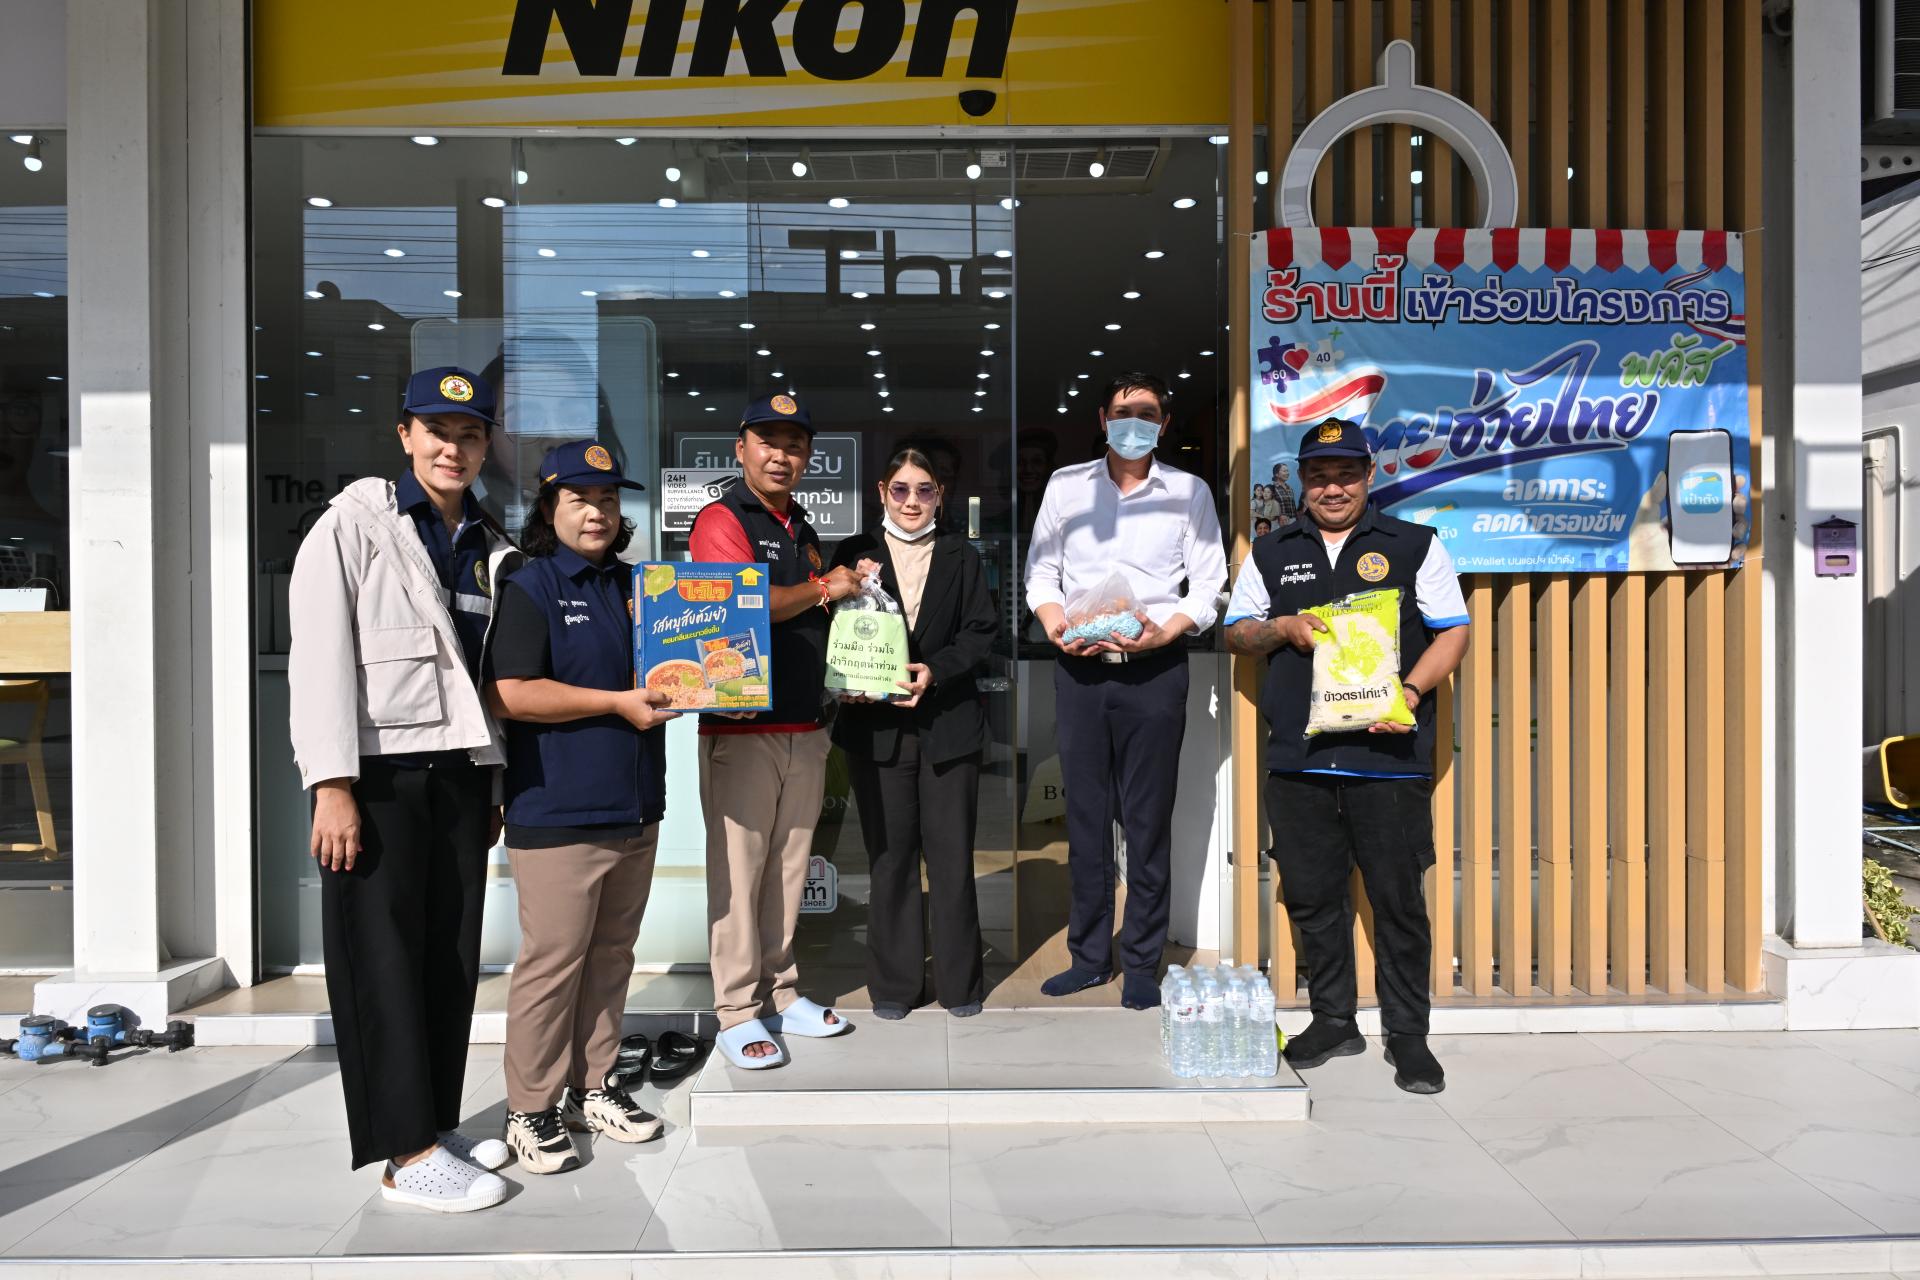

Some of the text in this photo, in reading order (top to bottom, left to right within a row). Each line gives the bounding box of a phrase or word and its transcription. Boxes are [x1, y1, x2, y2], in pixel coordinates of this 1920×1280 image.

[501, 0, 1019, 81] Nikon
[1263, 255, 1730, 324] ร้านนี้ เข้าร่วมโครงการ
[1316, 352, 1331, 363] 40
[1620, 332, 1736, 388] พลัส
[1272, 369, 1287, 380] 60
[667, 474, 686, 482] 24H
[264, 474, 323, 503] The
[1502, 478, 1607, 501] ลดภาระ
[1472, 508, 1627, 533] ลดค่าครองชีพ
[1457, 555, 1505, 566] G-Wallet
[652, 605, 727, 635] รสหมูสับต้มยำ
[833, 638, 895, 655] ร่วมมือ ร่วมใจ
[830, 655, 897, 671] ฝ่าวิกฤตน้ำท่วม
[1324, 686, 1388, 702] ข้าวตราไก่แจ้
